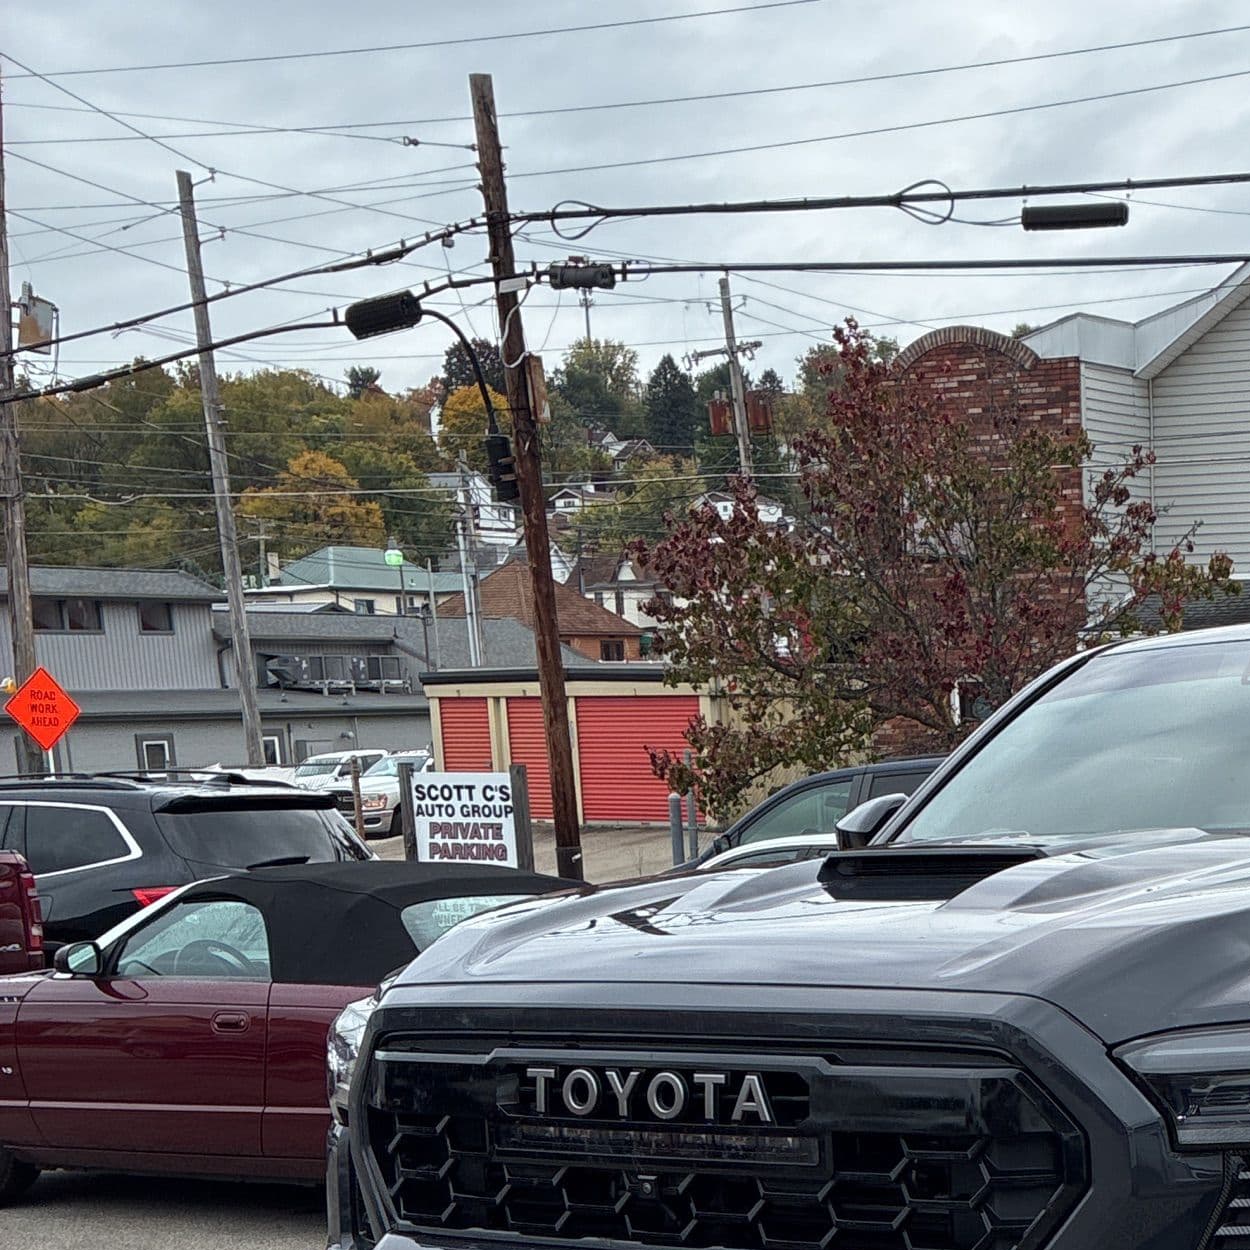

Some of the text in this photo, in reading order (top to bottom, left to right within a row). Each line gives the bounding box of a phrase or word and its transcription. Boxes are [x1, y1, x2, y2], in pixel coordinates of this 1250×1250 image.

[30, 690, 56, 700] ROAD
[30, 704, 58, 713] WORK
[31, 716, 59, 727] AHEAD
[414, 783, 511, 801] SCOTT C'S
[415, 803, 514, 818] AUTO GROUP
[428, 821, 504, 840] PRIVATE
[428, 842, 508, 861] PARKING
[526, 1067, 773, 1123] TOYOTA
